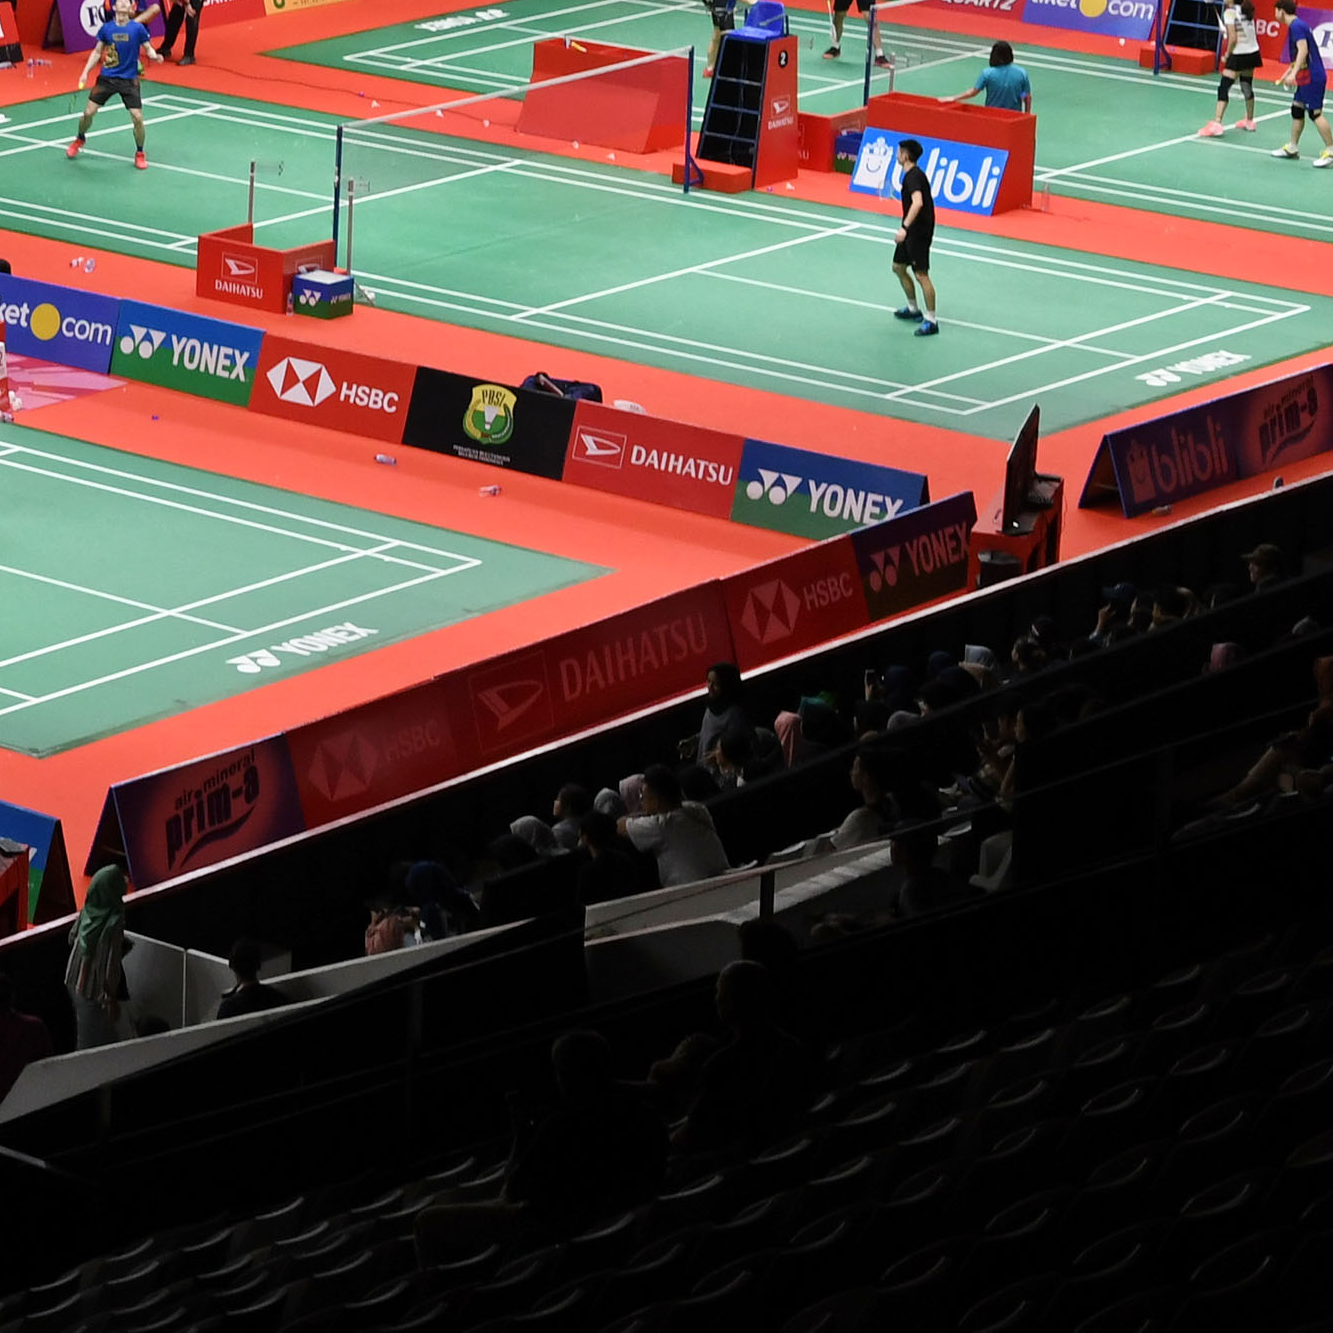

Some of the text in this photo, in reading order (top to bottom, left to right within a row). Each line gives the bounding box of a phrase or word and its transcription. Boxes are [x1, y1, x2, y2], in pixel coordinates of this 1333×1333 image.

[780, 51, 787, 66] 2
[215, 280, 263, 299] DAIHATSU
[61, 318, 112, 348] com
[170, 334, 250, 383] YONEX
[339, 381, 400, 414] HSBC
[630, 443, 734, 486] DAIHATSU
[1150, 415, 1229, 494] blibli
[808, 479, 904, 525] YONEX
[904, 517, 971, 574] YONEX
[802, 573, 855, 614] HSBC
[272, 621, 379, 658] YONEX
[560, 612, 709, 703] DAIHATSU
[387, 718, 442, 762] HSBC
[165, 765, 259, 870] prim-a
